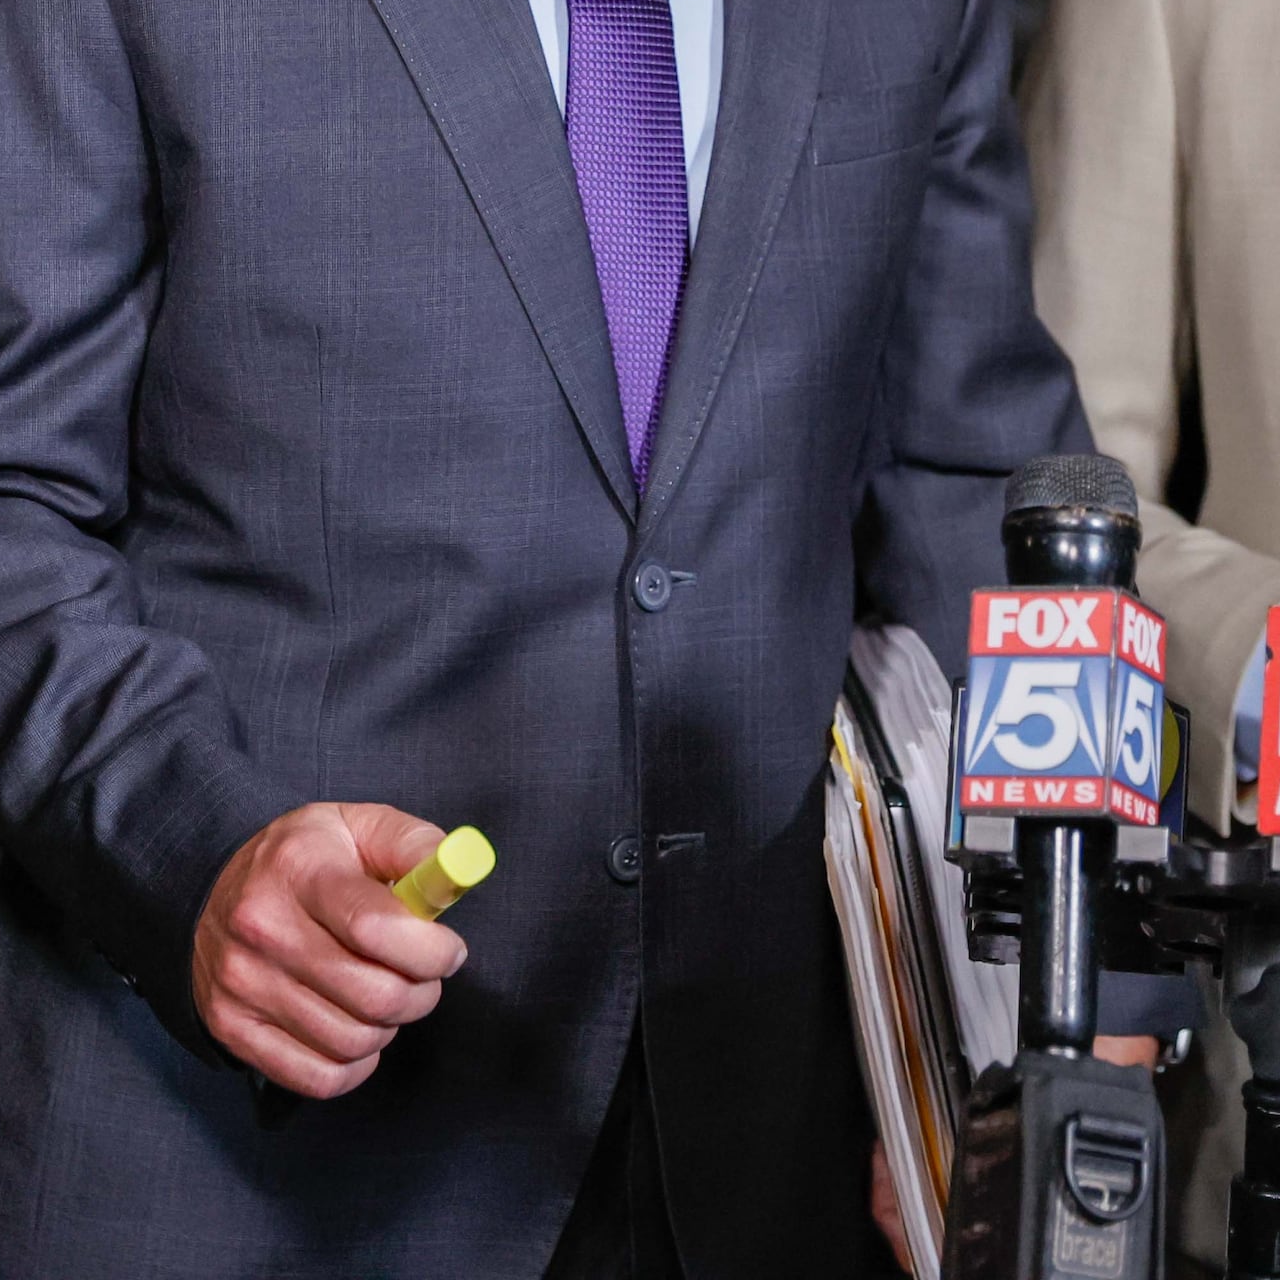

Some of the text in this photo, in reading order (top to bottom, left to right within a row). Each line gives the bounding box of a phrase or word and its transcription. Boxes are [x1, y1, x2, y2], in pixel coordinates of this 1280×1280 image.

[987, 598, 1099, 648] FOX
[1122, 602, 1162, 674] FOX
[993, 662, 1081, 770] 5
[1122, 672, 1154, 786] 5
[970, 779, 1097, 803] NEWS
[1112, 785, 1156, 826] NEWS
